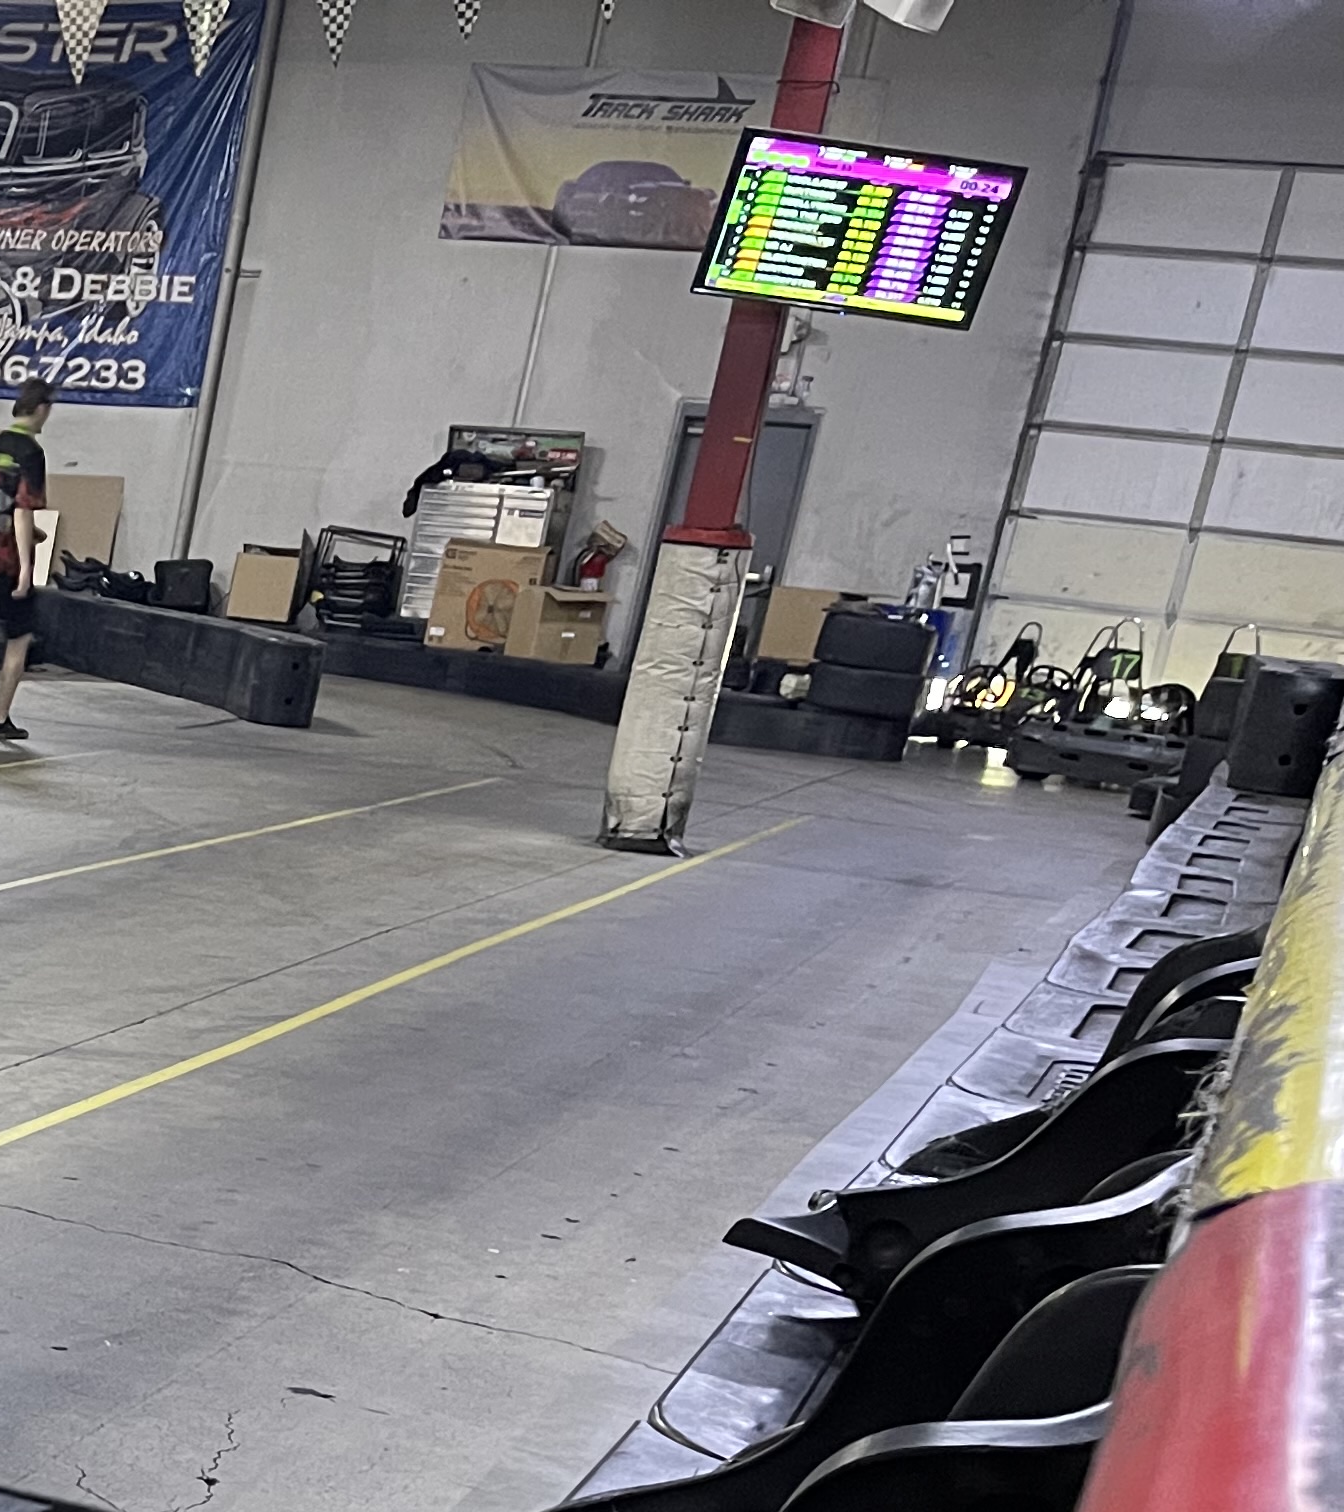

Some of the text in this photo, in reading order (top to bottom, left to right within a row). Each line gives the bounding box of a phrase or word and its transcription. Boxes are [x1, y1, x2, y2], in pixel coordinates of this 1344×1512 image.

[581, 93, 750, 123] TRACK SHARK
[51, 230, 164, 252] OPERATORS
[12, 267, 41, 298] &
[1111, 653, 1140, 679] 17
